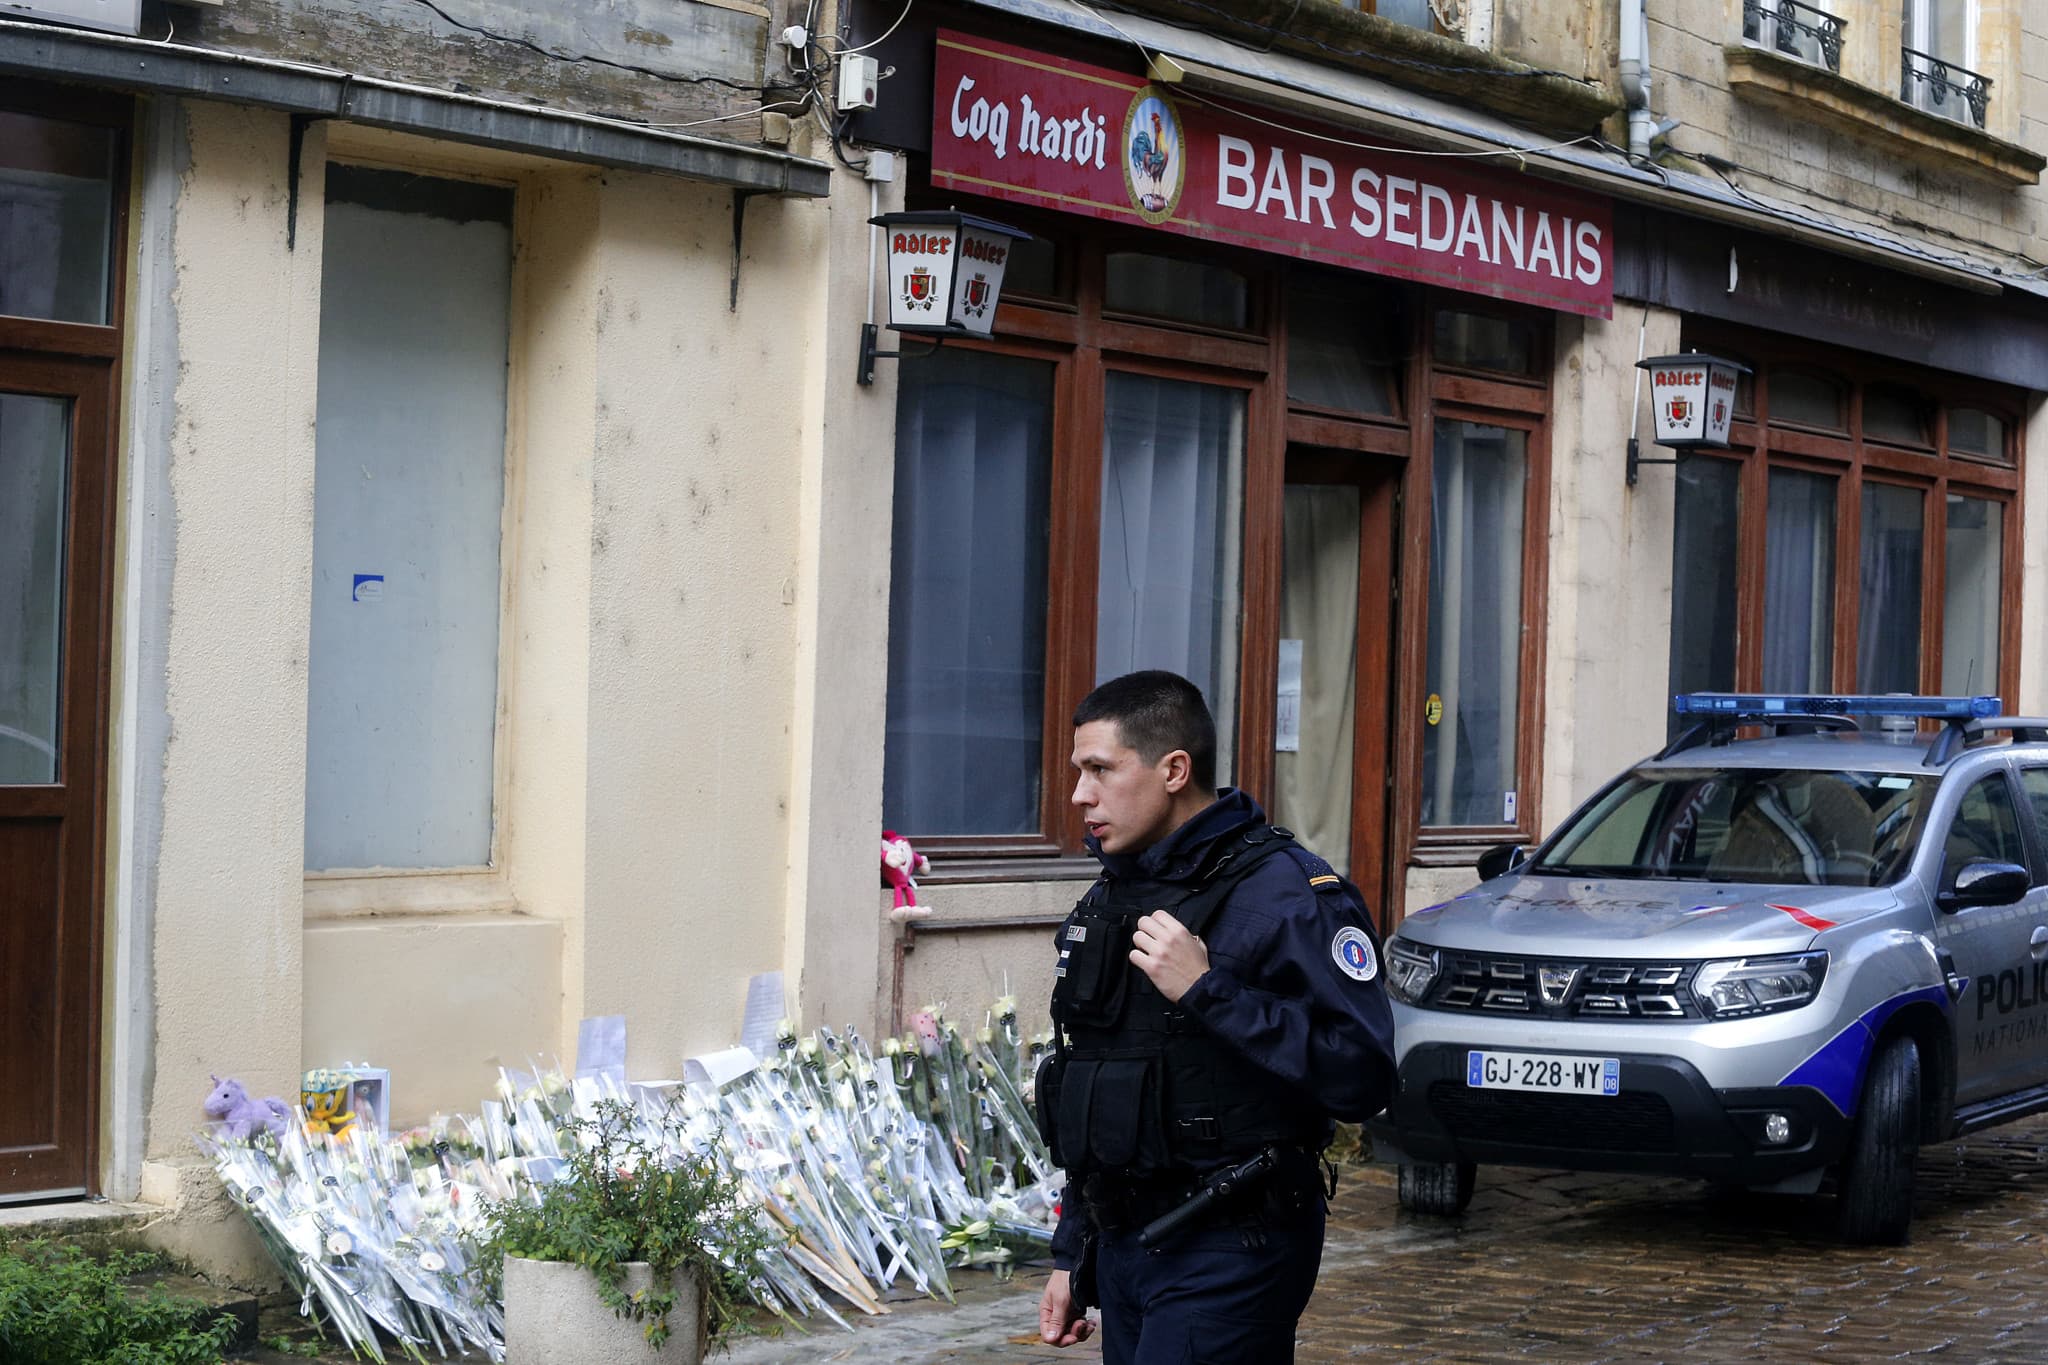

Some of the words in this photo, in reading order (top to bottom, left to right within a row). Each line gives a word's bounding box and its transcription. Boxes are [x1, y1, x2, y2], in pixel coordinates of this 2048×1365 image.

[951, 74, 1010, 160] Coq
[1017, 93, 1106, 170] hardi
[1216, 134, 1337, 230] BAR
[1350, 167, 1602, 286] SEDANAIS
[893, 233, 952, 255] Adler
[961, 237, 1006, 265] Adler
[1655, 370, 1704, 387] Adler
[1485, 1057, 1600, 1089] GJ-228-WY
[1604, 1077, 1617, 1090] 08
